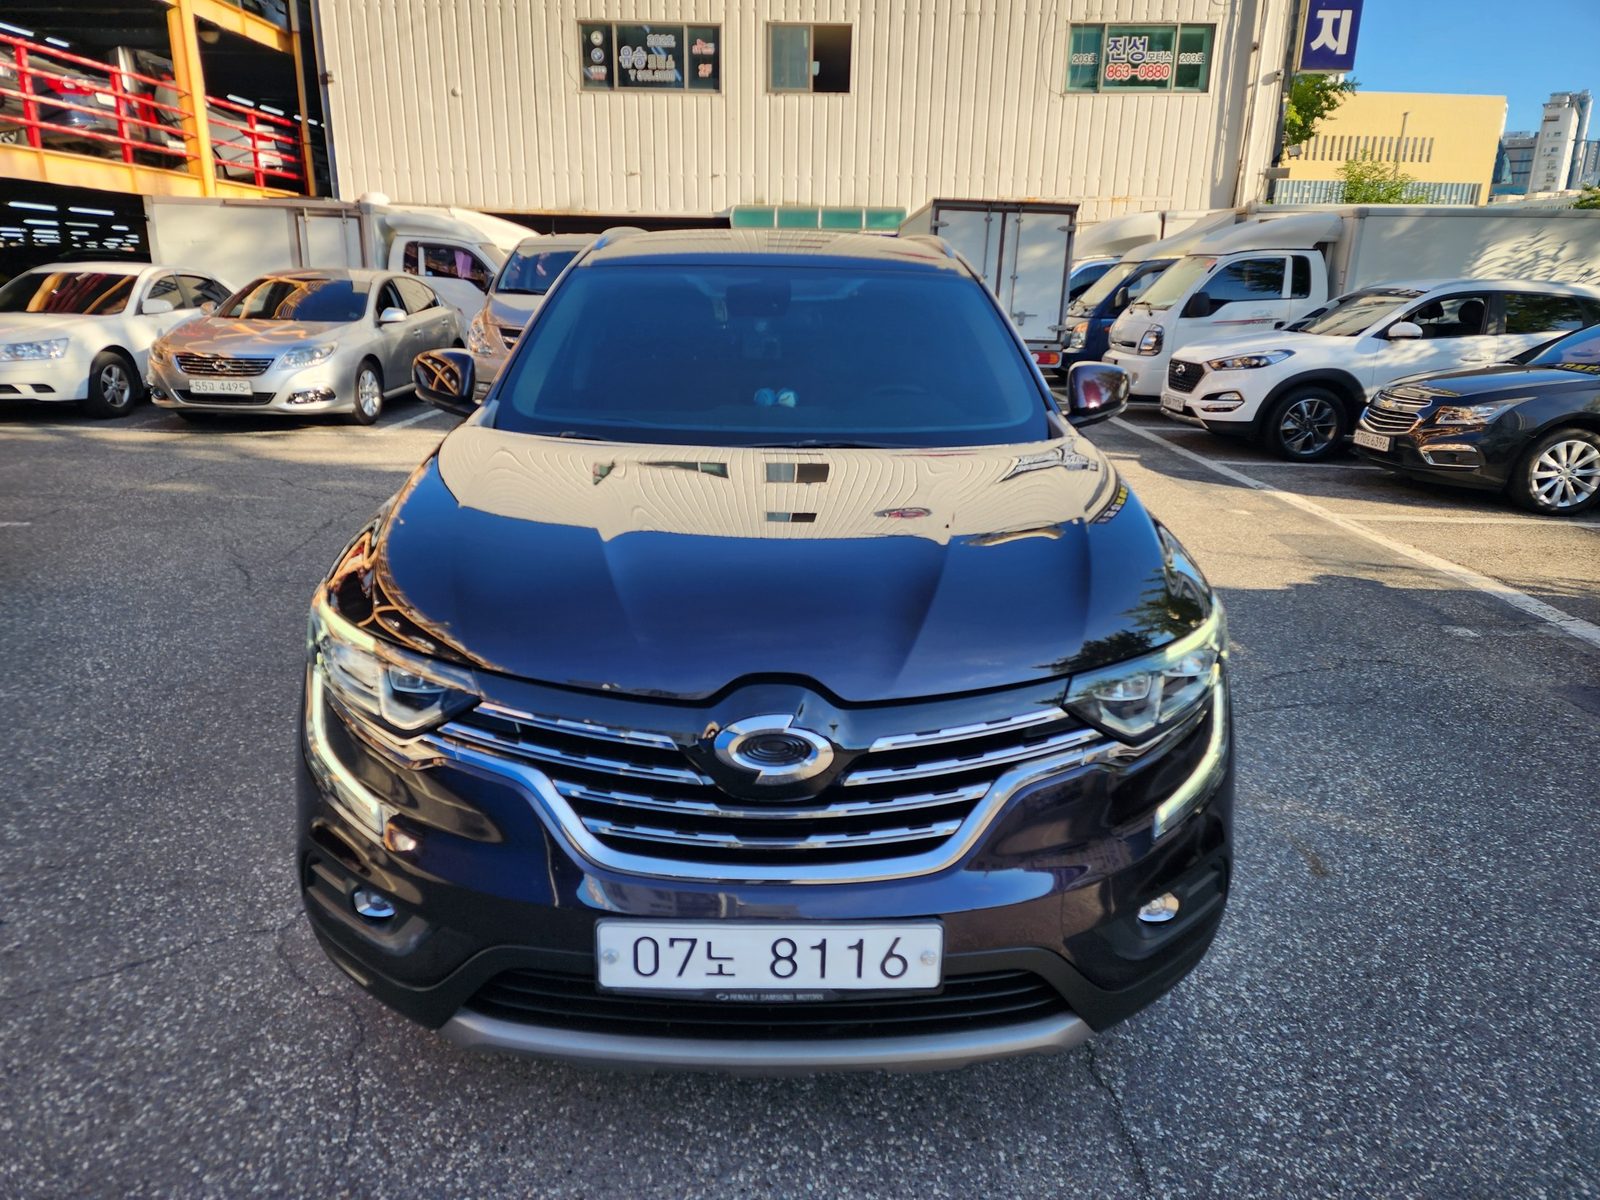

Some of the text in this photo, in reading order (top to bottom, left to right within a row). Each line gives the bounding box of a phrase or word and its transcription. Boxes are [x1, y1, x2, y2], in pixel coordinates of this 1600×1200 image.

[1310, 9, 1353, 55] 지
[1107, 36, 1173, 63] 진성 모터스
[1105, 63, 1171, 80] 863-0880
[219, 382, 245, 393] 4495
[632, 936, 909, 979] 07노 8116
